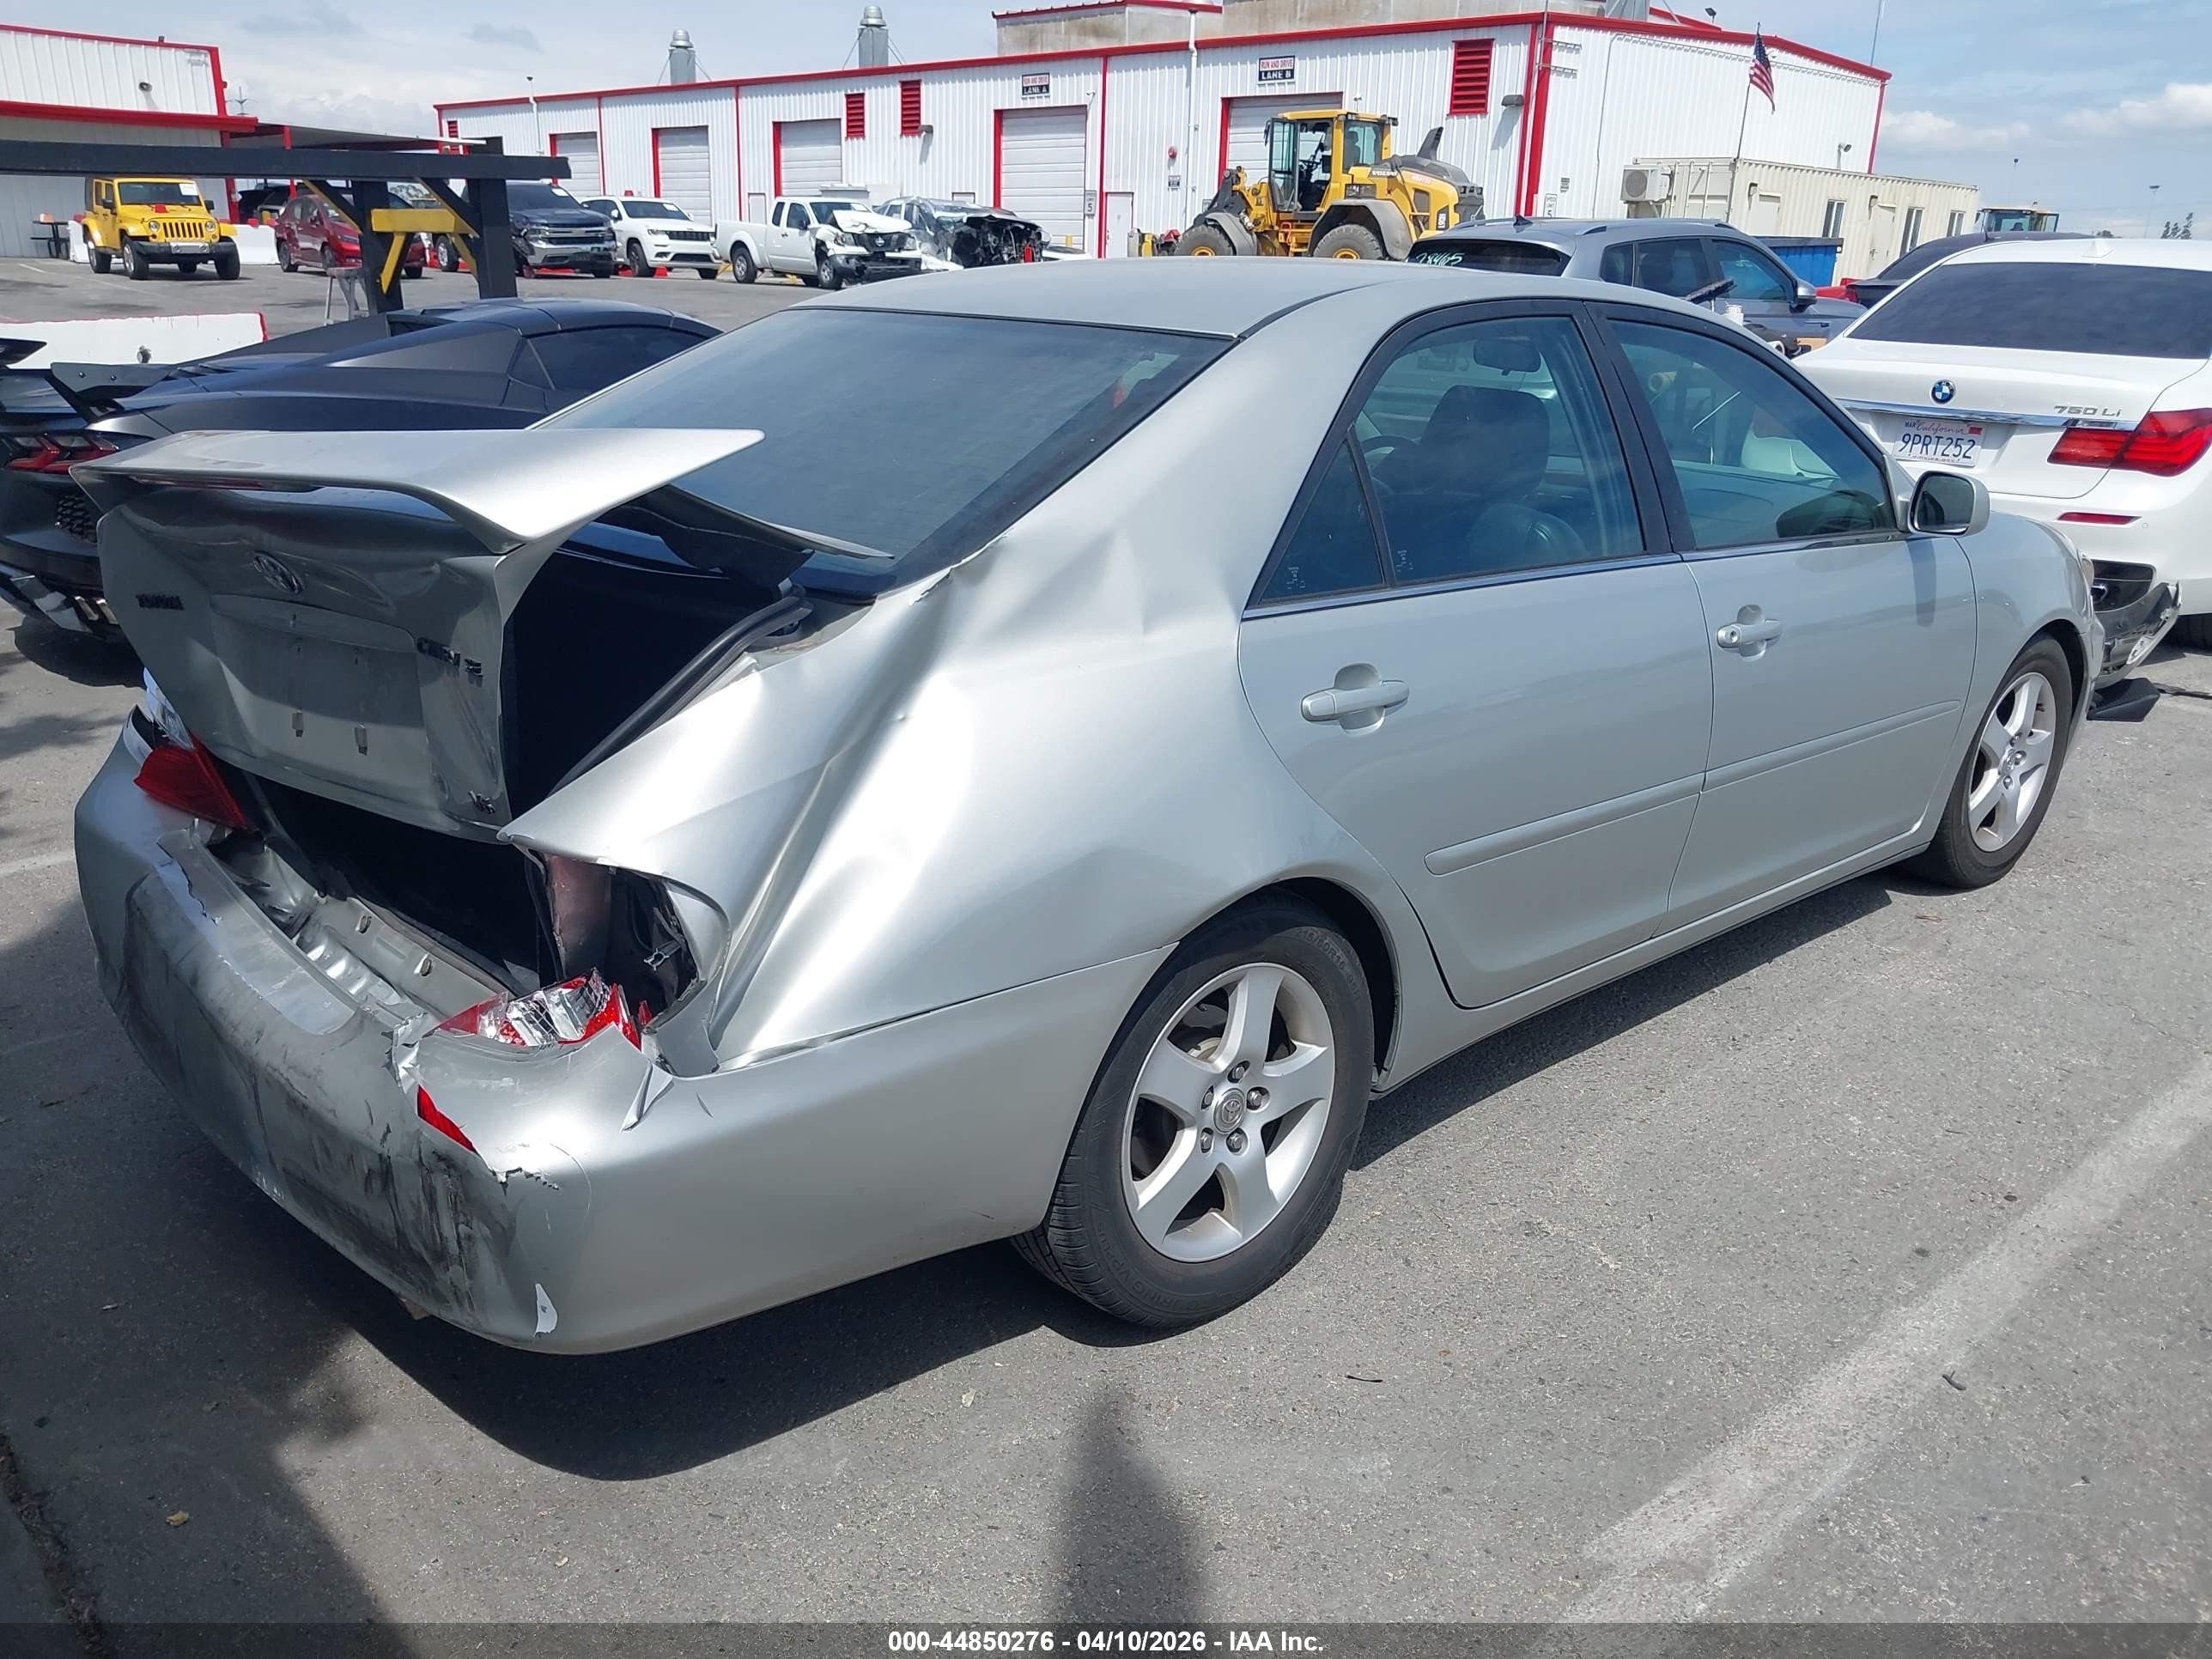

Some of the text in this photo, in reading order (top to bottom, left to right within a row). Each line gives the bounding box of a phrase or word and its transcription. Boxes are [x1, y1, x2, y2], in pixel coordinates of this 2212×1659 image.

[1280, 59, 1292, 68] DRIVE
[1261, 70, 1291, 80] LANE B
[1024, 86, 1041, 94] LANE
[1087, 203, 1093, 212] 5
[2054, 405, 2098, 416] 750
[1916, 420, 1967, 434] California
[1899, 433, 1976, 459] 9PRT252
